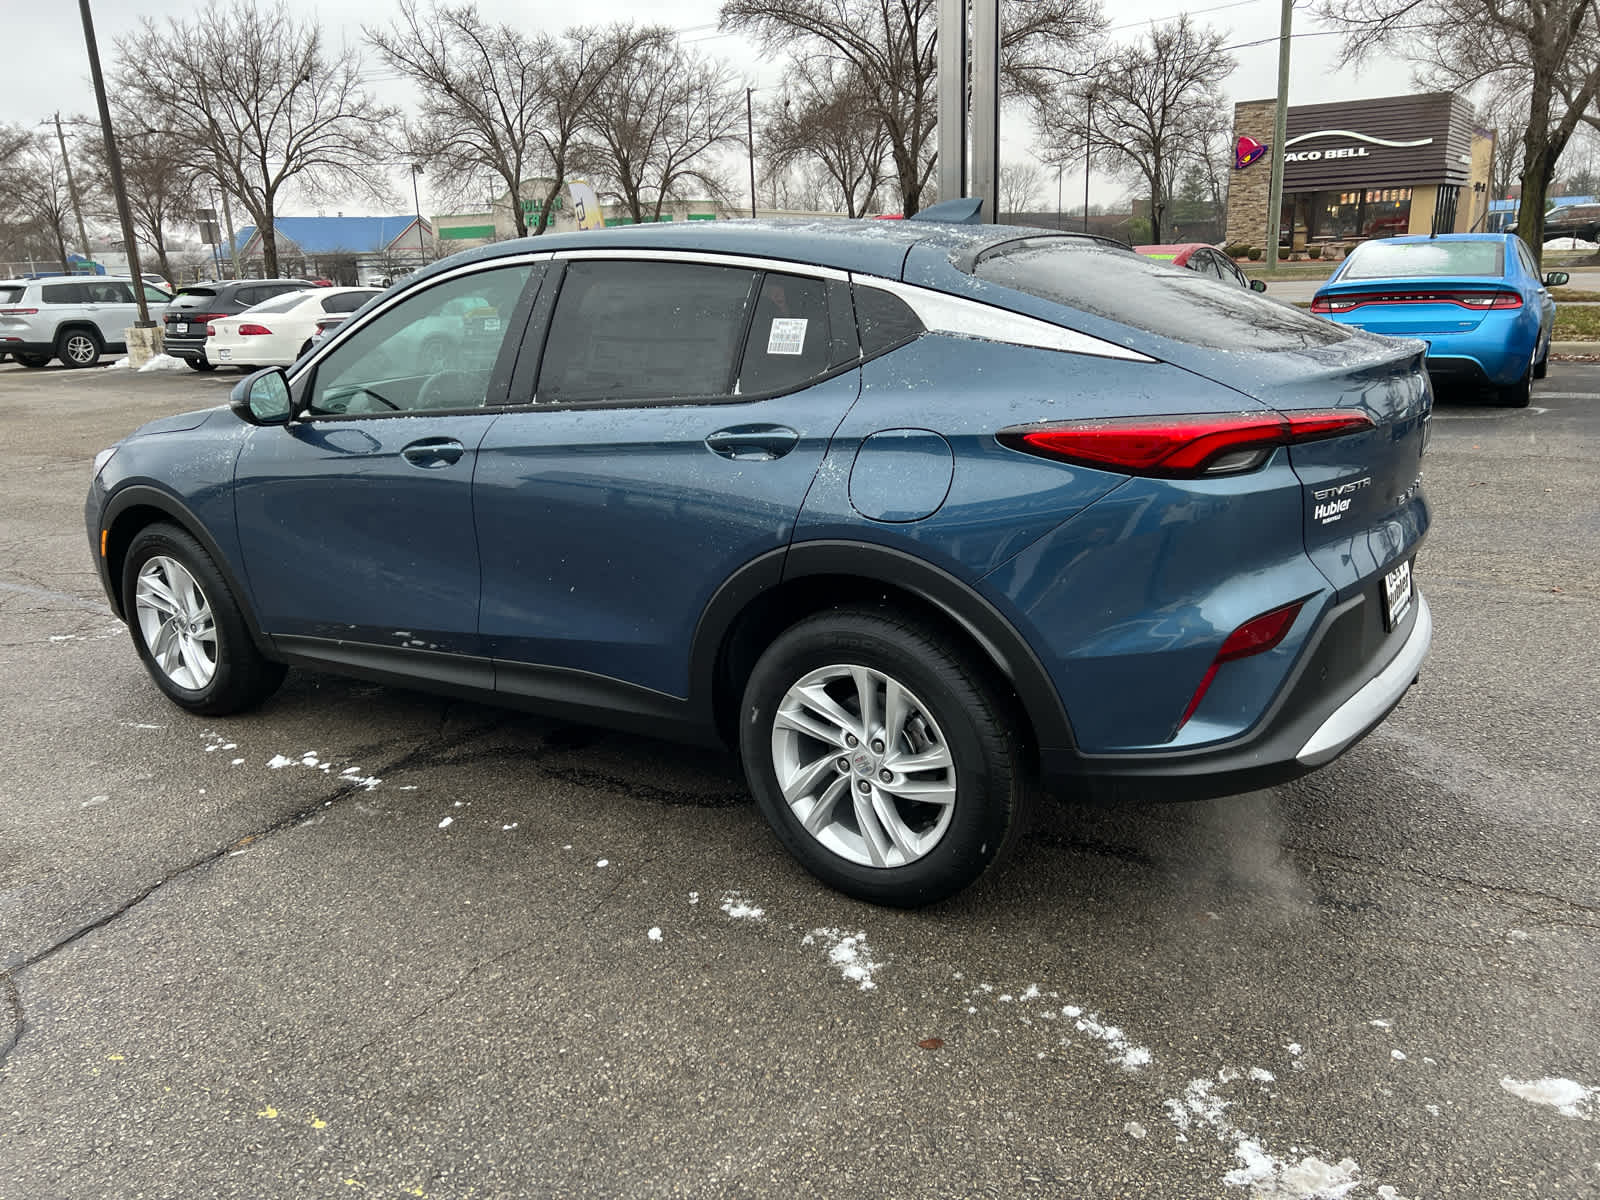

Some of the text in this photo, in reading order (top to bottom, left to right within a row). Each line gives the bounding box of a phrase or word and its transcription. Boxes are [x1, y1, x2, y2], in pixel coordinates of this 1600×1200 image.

[1324, 147, 1370, 159] BELL
[524, 213, 554, 227] TRE
[1314, 499, 1352, 520] Hubler
